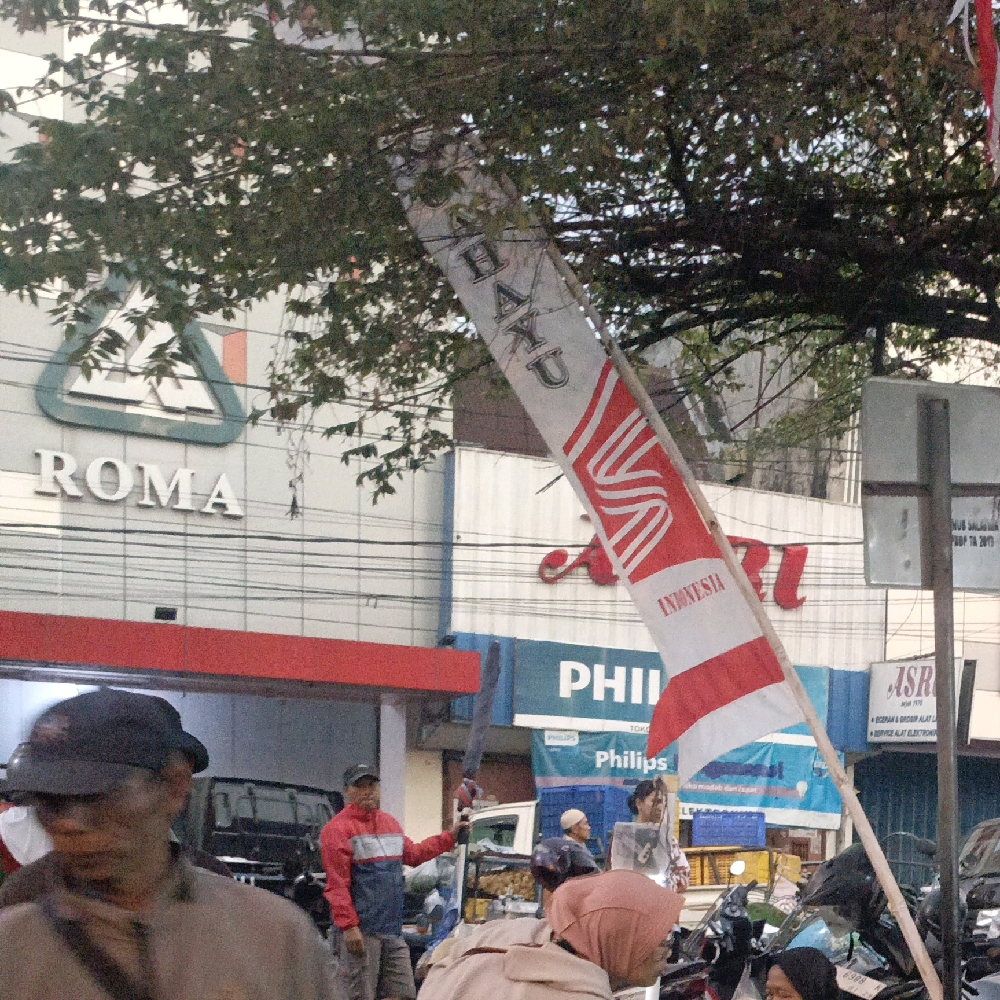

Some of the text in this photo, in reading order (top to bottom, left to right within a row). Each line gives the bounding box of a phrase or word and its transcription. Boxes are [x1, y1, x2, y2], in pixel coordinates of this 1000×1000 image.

[35, 449, 245, 517] ROMA
[657, 573, 726, 617] INDONESIA
[559, 660, 661, 706] PHIL
[595, 749, 668, 774] Philips
